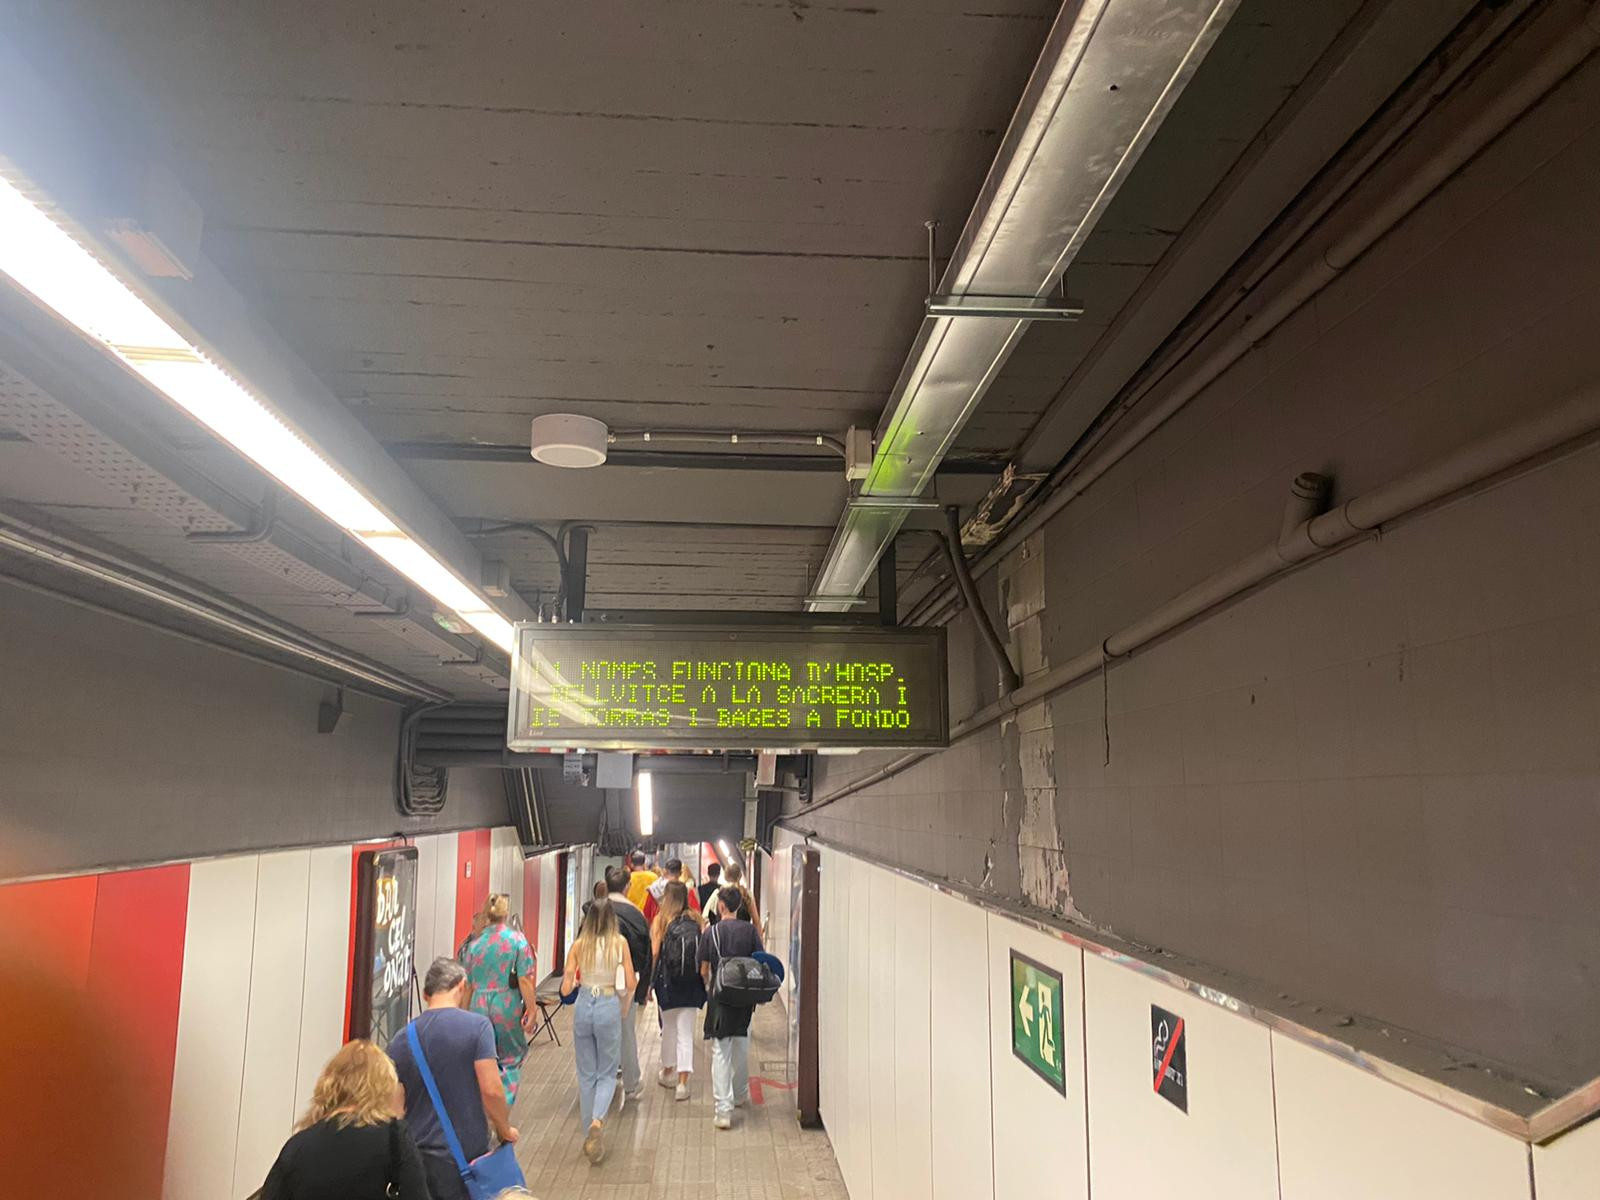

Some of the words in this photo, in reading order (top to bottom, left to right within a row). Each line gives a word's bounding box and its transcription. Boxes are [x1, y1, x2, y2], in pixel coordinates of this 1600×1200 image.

[731, 684, 761, 704] LA
[897, 686, 907, 705] I
[688, 708, 698, 727] I
[717, 708, 791, 728] BAGES
[806, 708, 821, 728] A
[836, 709, 910, 729] FONDO
